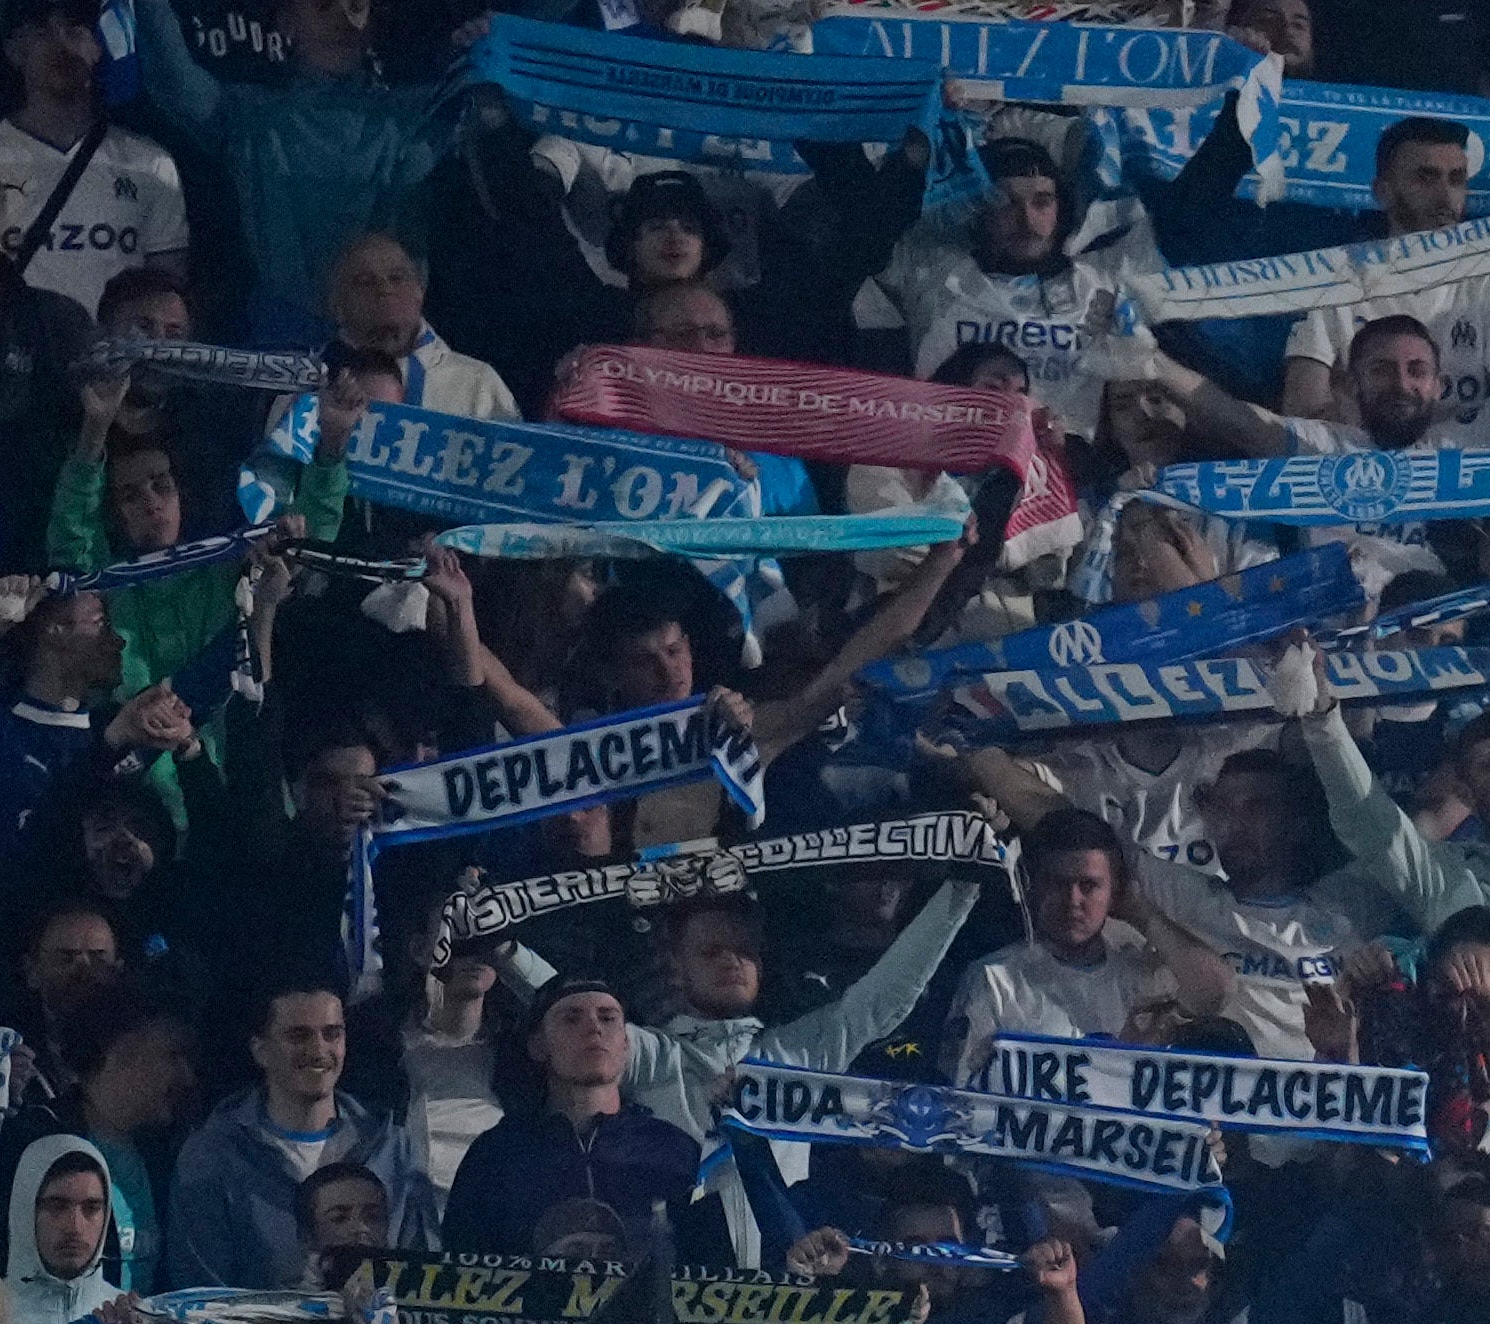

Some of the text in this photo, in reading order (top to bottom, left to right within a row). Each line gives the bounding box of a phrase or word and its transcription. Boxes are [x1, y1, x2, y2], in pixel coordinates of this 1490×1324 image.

[863, 21, 1219, 87] ALLEZ L'OM
[601, 358, 844, 411] OLYMPIQUE DE
